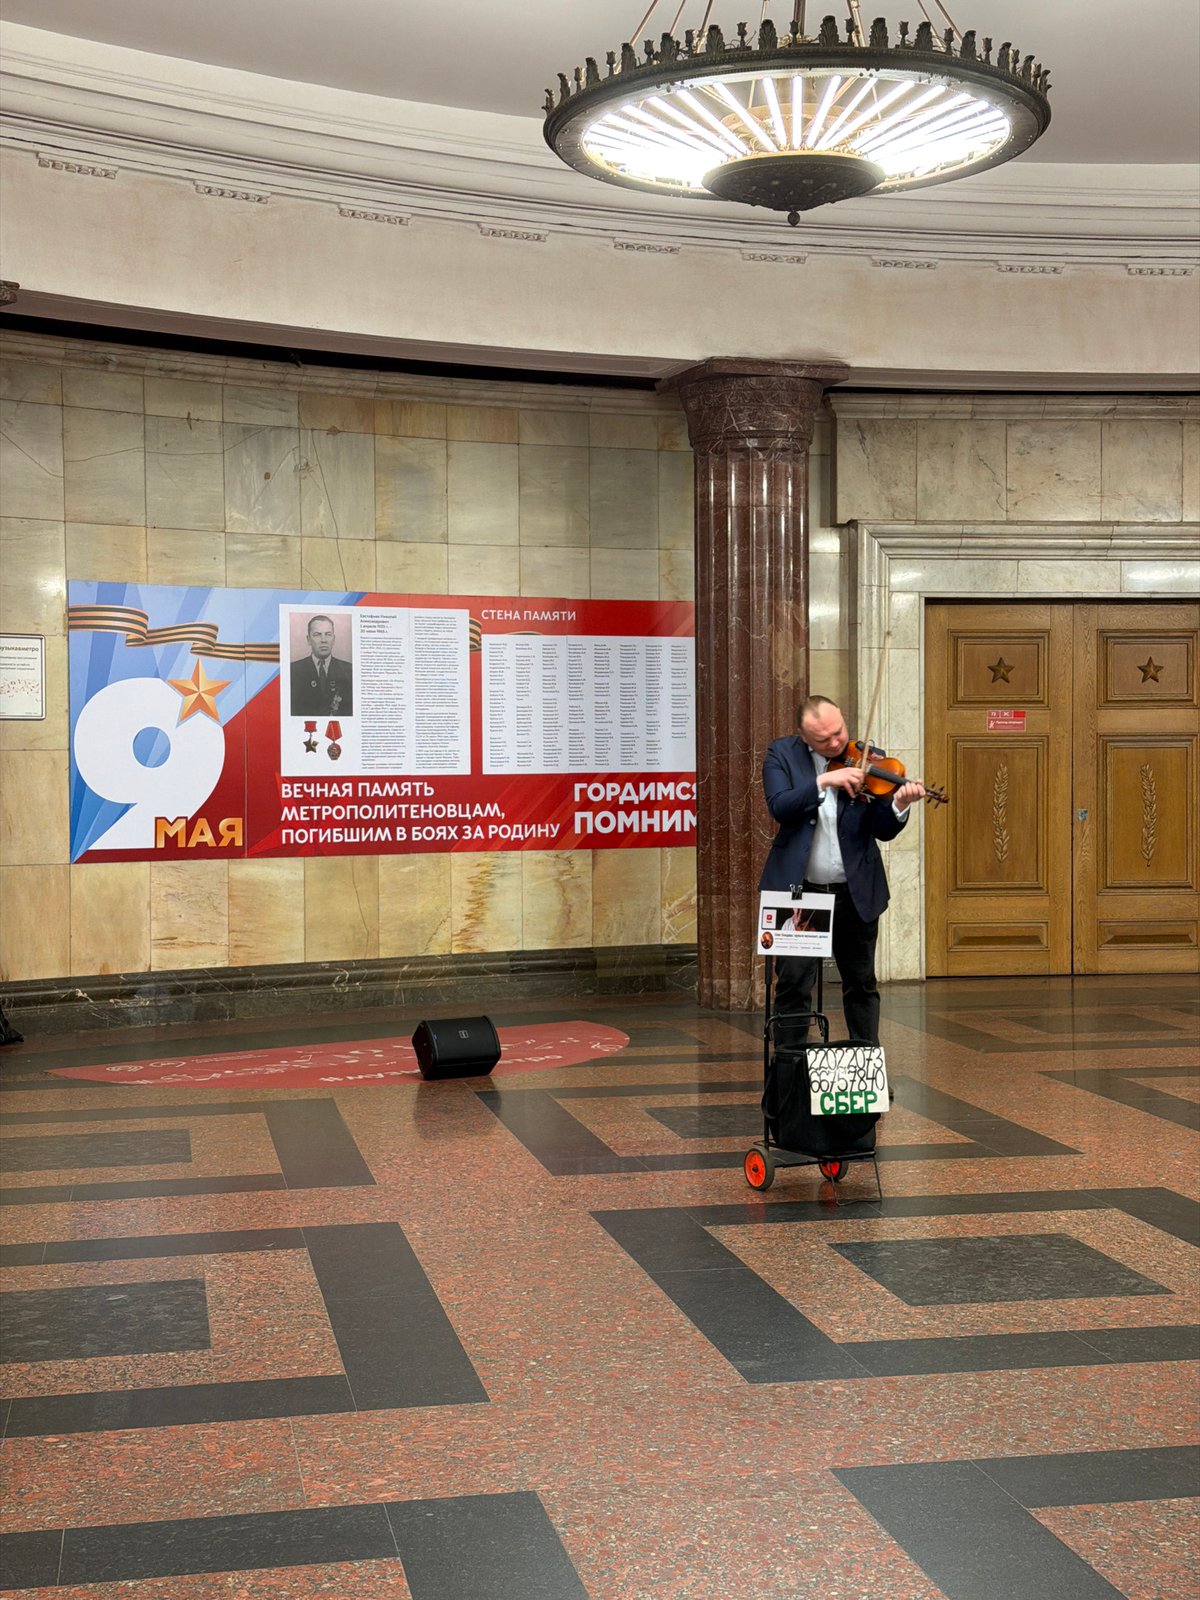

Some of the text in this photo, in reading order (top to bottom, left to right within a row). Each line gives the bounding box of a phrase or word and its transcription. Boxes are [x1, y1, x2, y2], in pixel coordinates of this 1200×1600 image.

[481, 609, 577, 621] СТЕНА ПАМЯТИ
[73, 677, 226, 850] 9
[281, 781, 435, 798] ВЕЧНАЯ ПАМЯТЬ
[281, 803, 505, 821] МЕТРОПОЛИТЕНОВЦАМ,
[156, 817, 243, 849] МАЯ
[282, 823, 560, 844] ПОГИБШИМ В БОЯХ ЗА РОДИНУ
[819, 1091, 878, 1115] СБЕР
